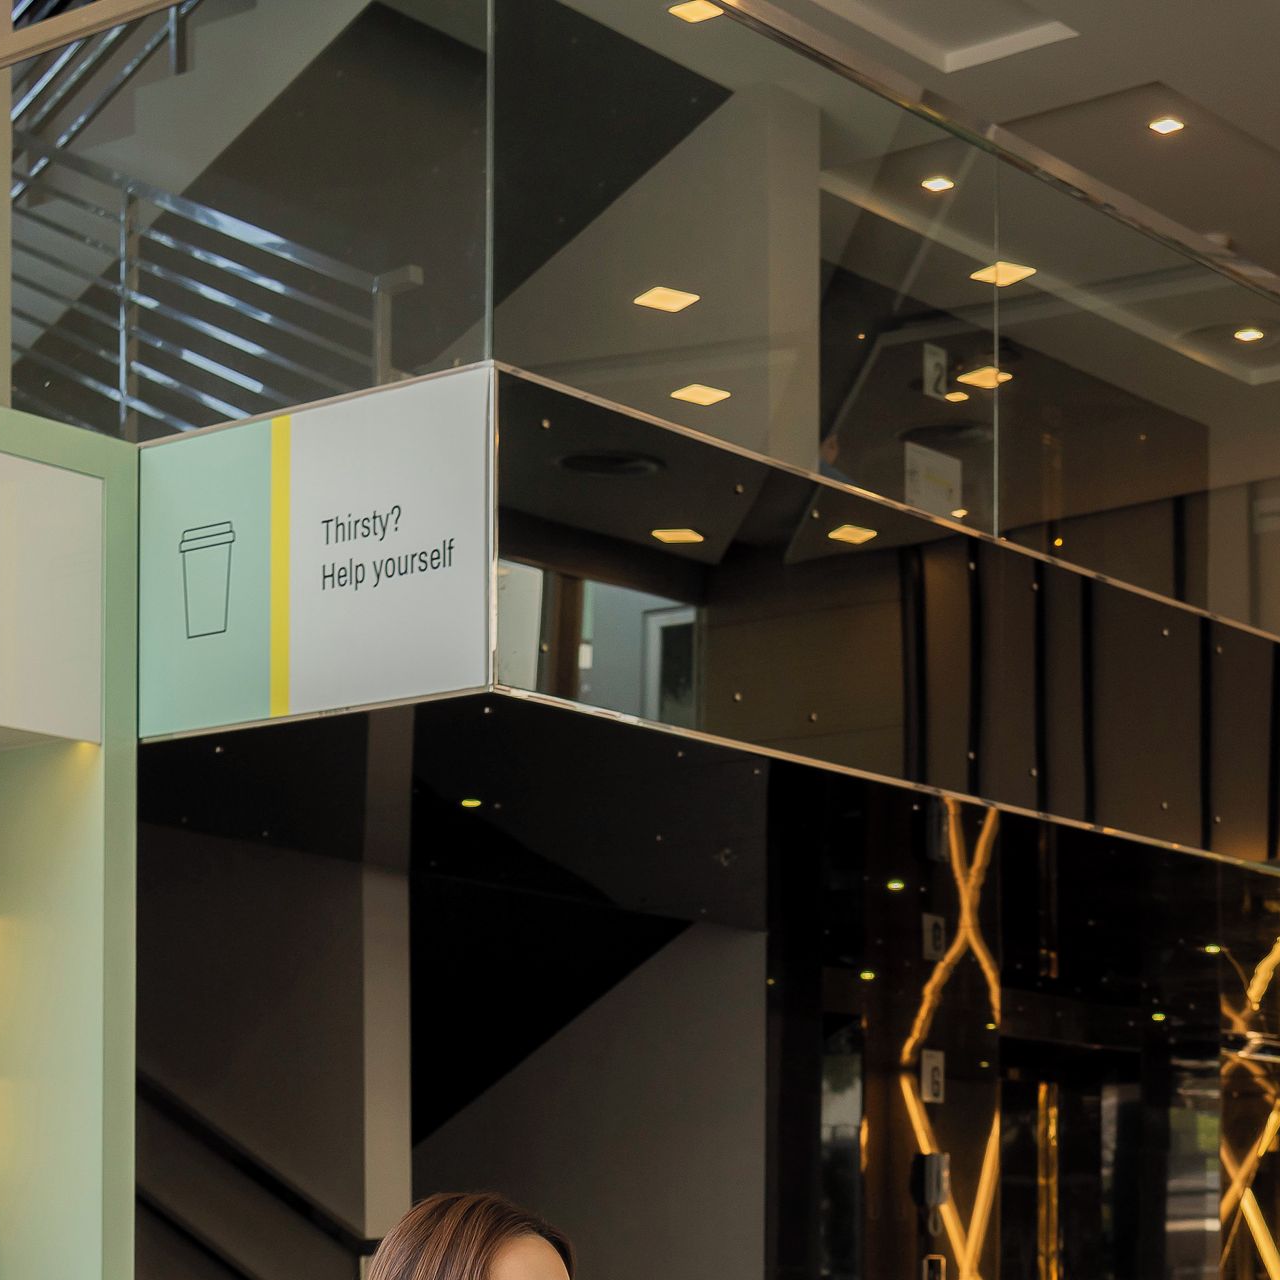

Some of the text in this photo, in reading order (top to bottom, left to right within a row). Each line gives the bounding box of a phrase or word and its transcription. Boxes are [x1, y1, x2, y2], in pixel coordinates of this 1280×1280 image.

[321, 504, 402, 545] Thirsty?
[322, 537, 455, 591] Help yourself
